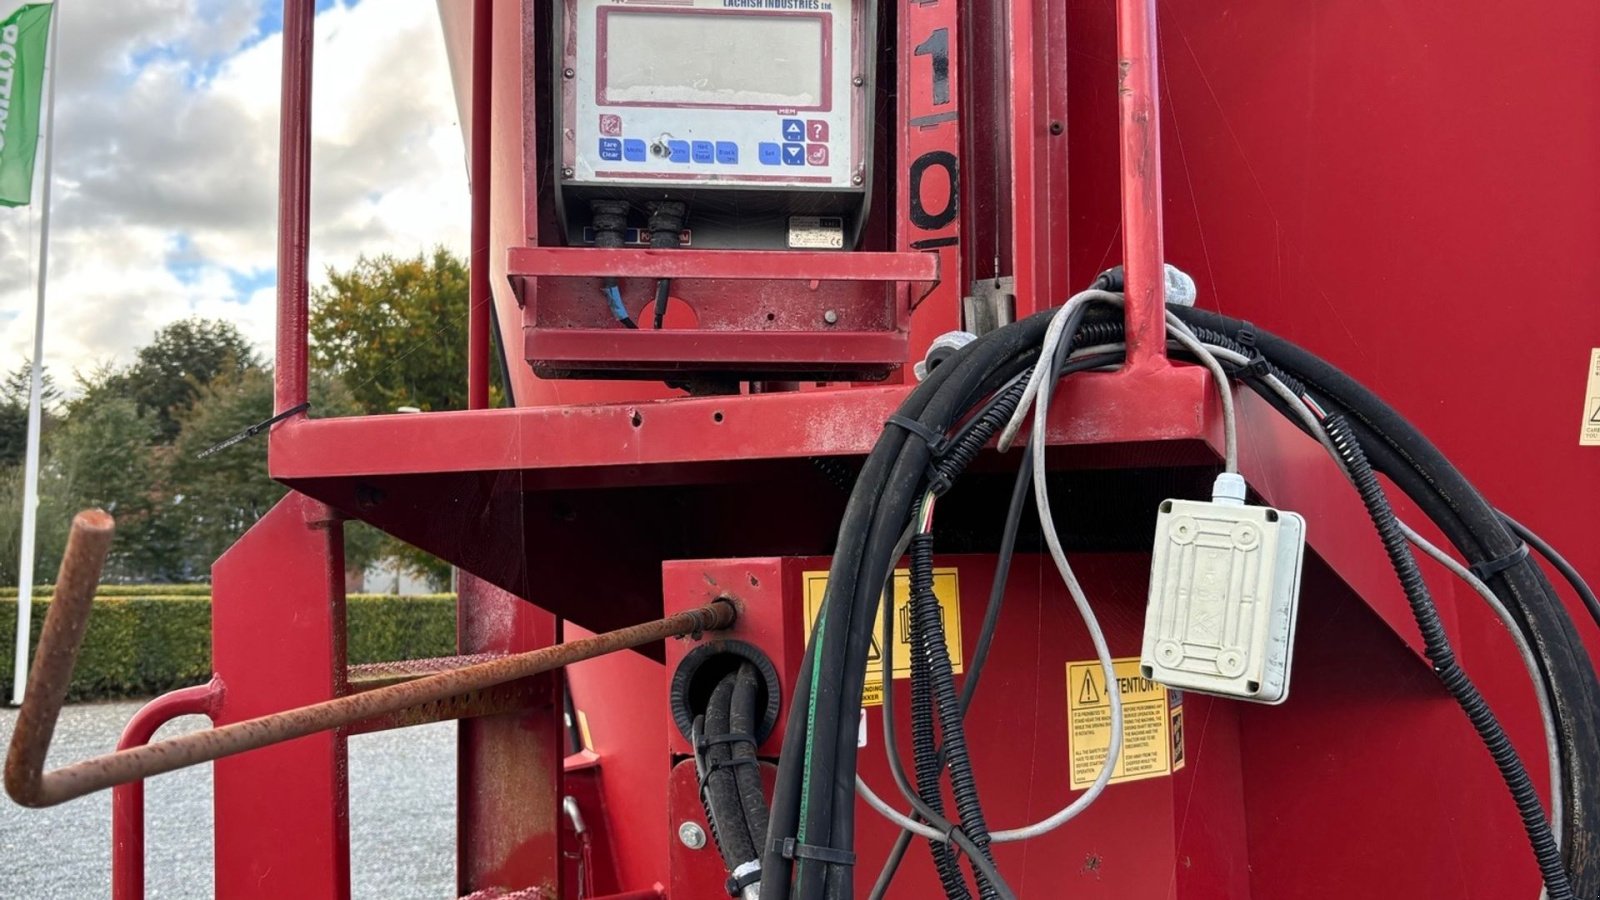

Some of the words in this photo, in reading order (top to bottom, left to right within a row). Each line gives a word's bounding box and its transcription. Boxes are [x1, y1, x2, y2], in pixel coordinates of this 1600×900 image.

[723, 0, 762, 8] LACHISH
[765, 0, 819, 9] INDUSTRIES
[914, 27, 949, 105] 1
[910, 150, 958, 230] 0
[1104, 677, 1154, 695] TENTION
